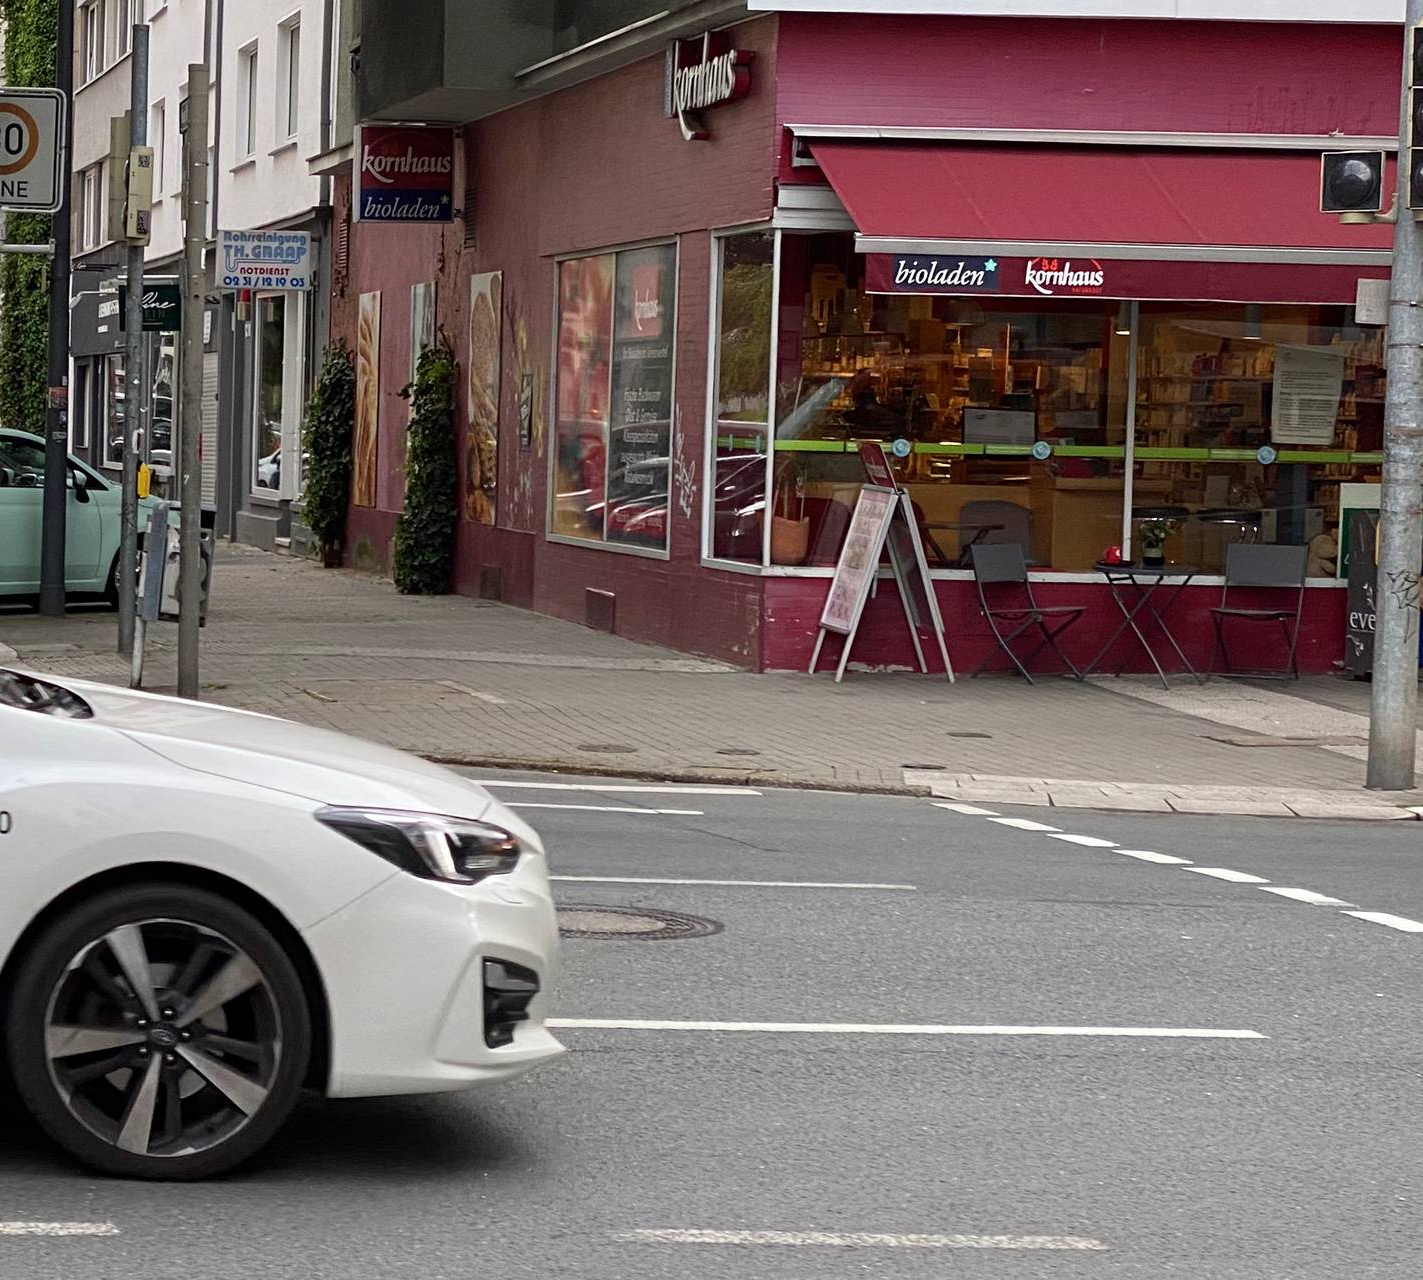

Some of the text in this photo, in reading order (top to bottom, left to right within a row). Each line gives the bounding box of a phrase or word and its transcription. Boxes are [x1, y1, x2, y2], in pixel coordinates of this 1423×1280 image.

[673, 31, 737, 140] kornhaus
[362, 145, 452, 183] kornhaus
[364, 196, 440, 218] bioladen
[224, 231, 307, 246] Rohrreinigung
[223, 276, 239, 286] 02
[262, 277, 273, 287] 12
[275, 277, 287, 287] 19
[239, 267, 290, 276] NOTDIENST
[895, 259, 985, 286] bioladen
[1025, 261, 1104, 295] kornhaus
[1349, 611, 1377, 632] eve
